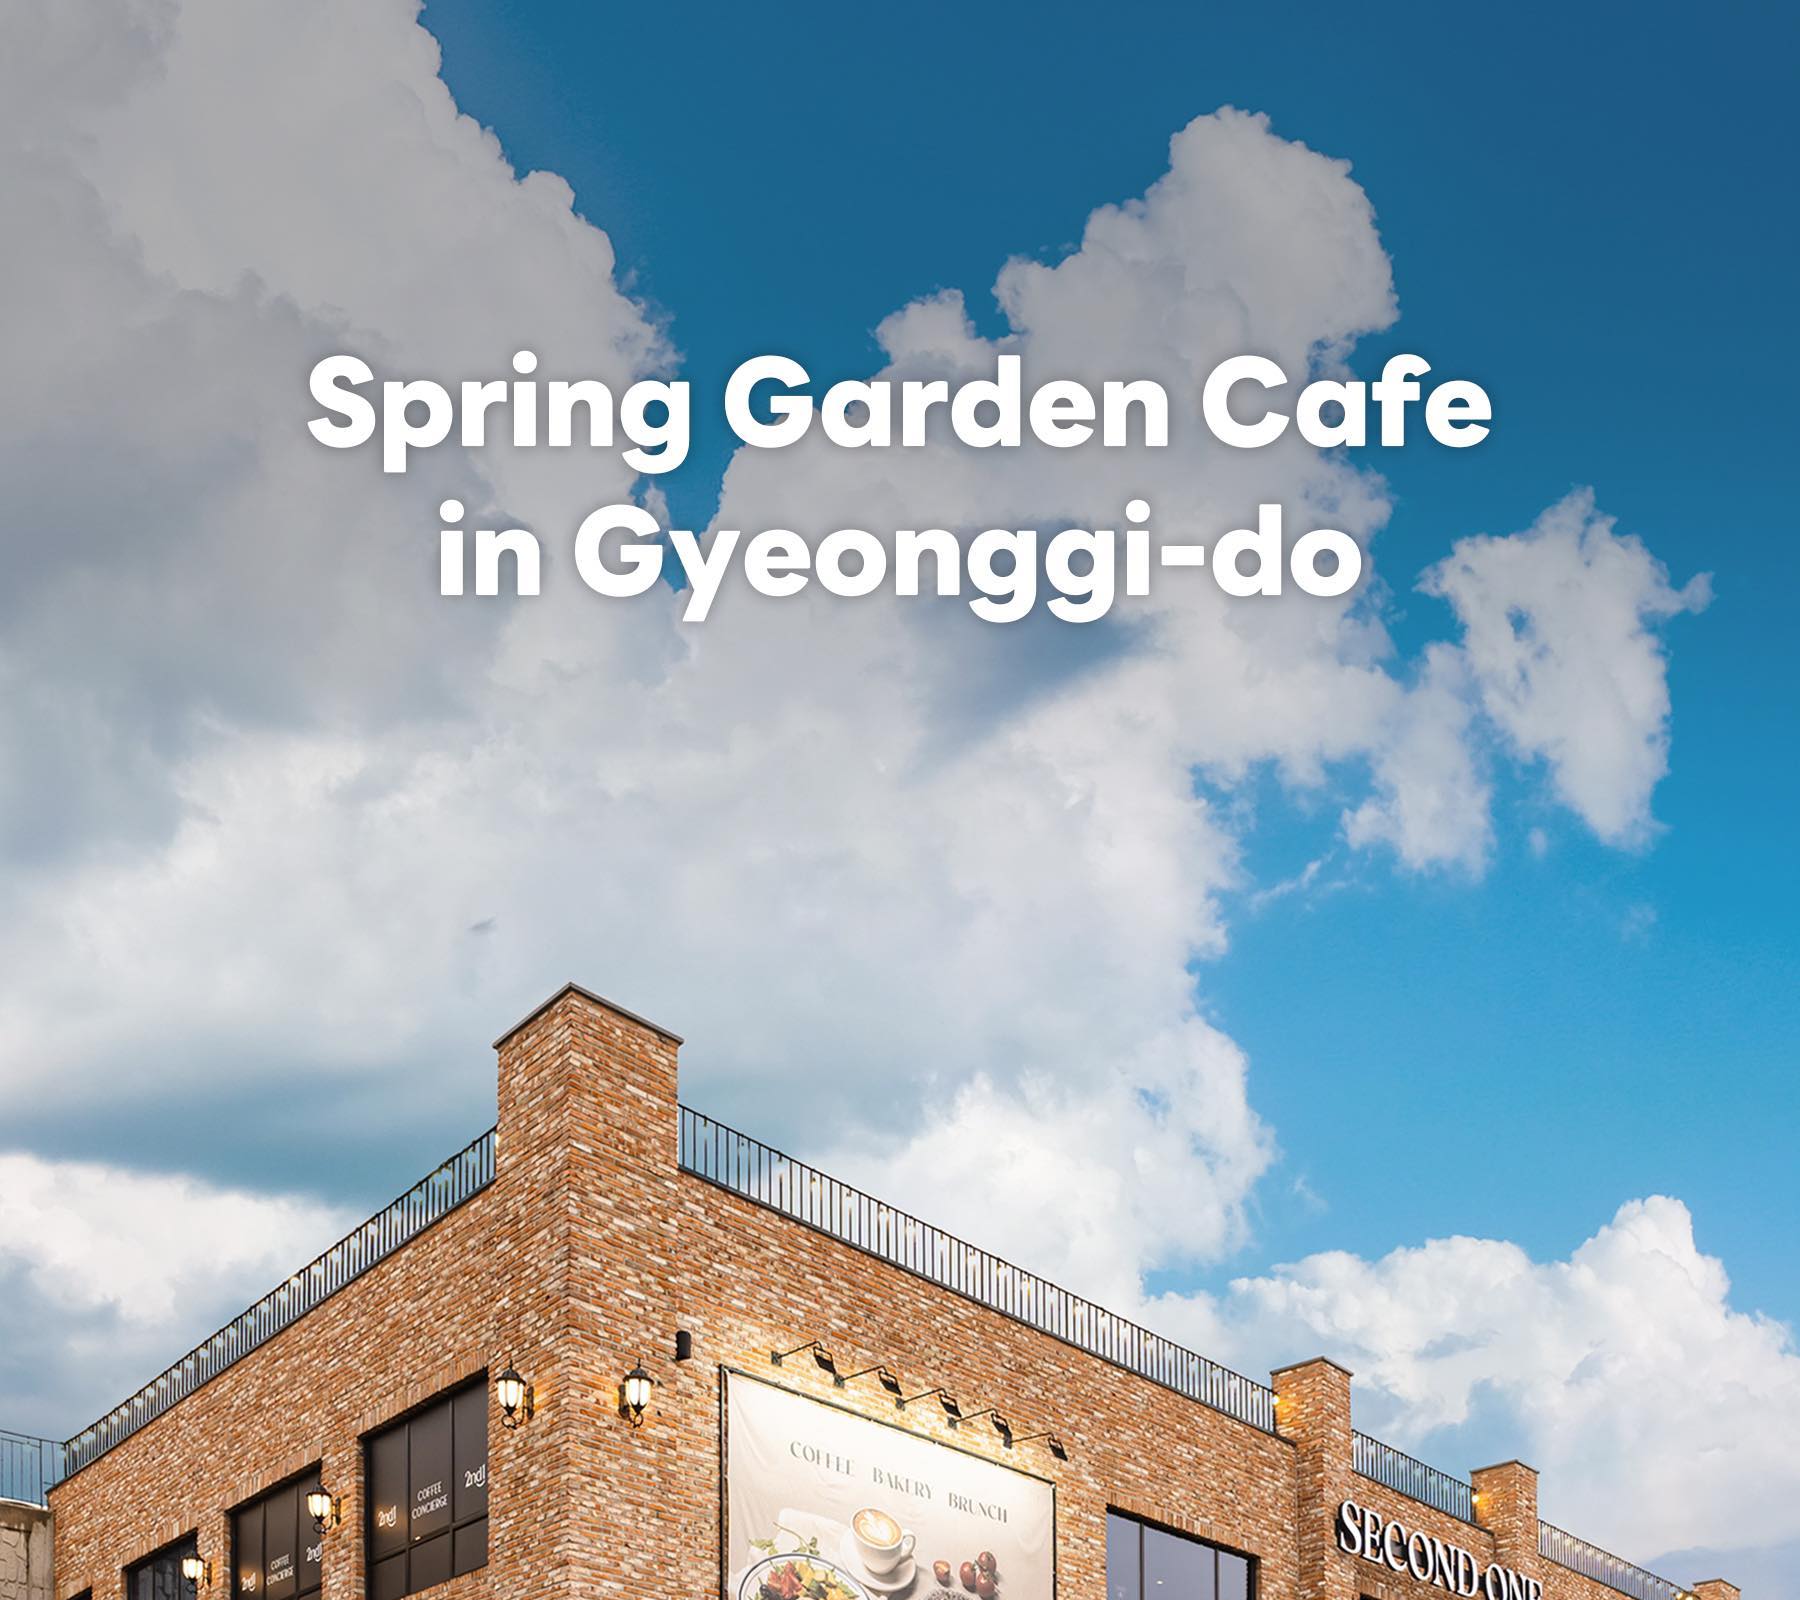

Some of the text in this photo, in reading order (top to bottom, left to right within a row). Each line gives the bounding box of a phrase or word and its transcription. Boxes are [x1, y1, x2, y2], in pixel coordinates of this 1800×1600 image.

[410, 1493, 449, 1520] CONCIERGE
[416, 1480, 443, 1502] COFFEE
[790, 1441, 1008, 1524] COFFEE BAKERY BRUNCH
[1339, 1500, 1479, 1598] SECOND
